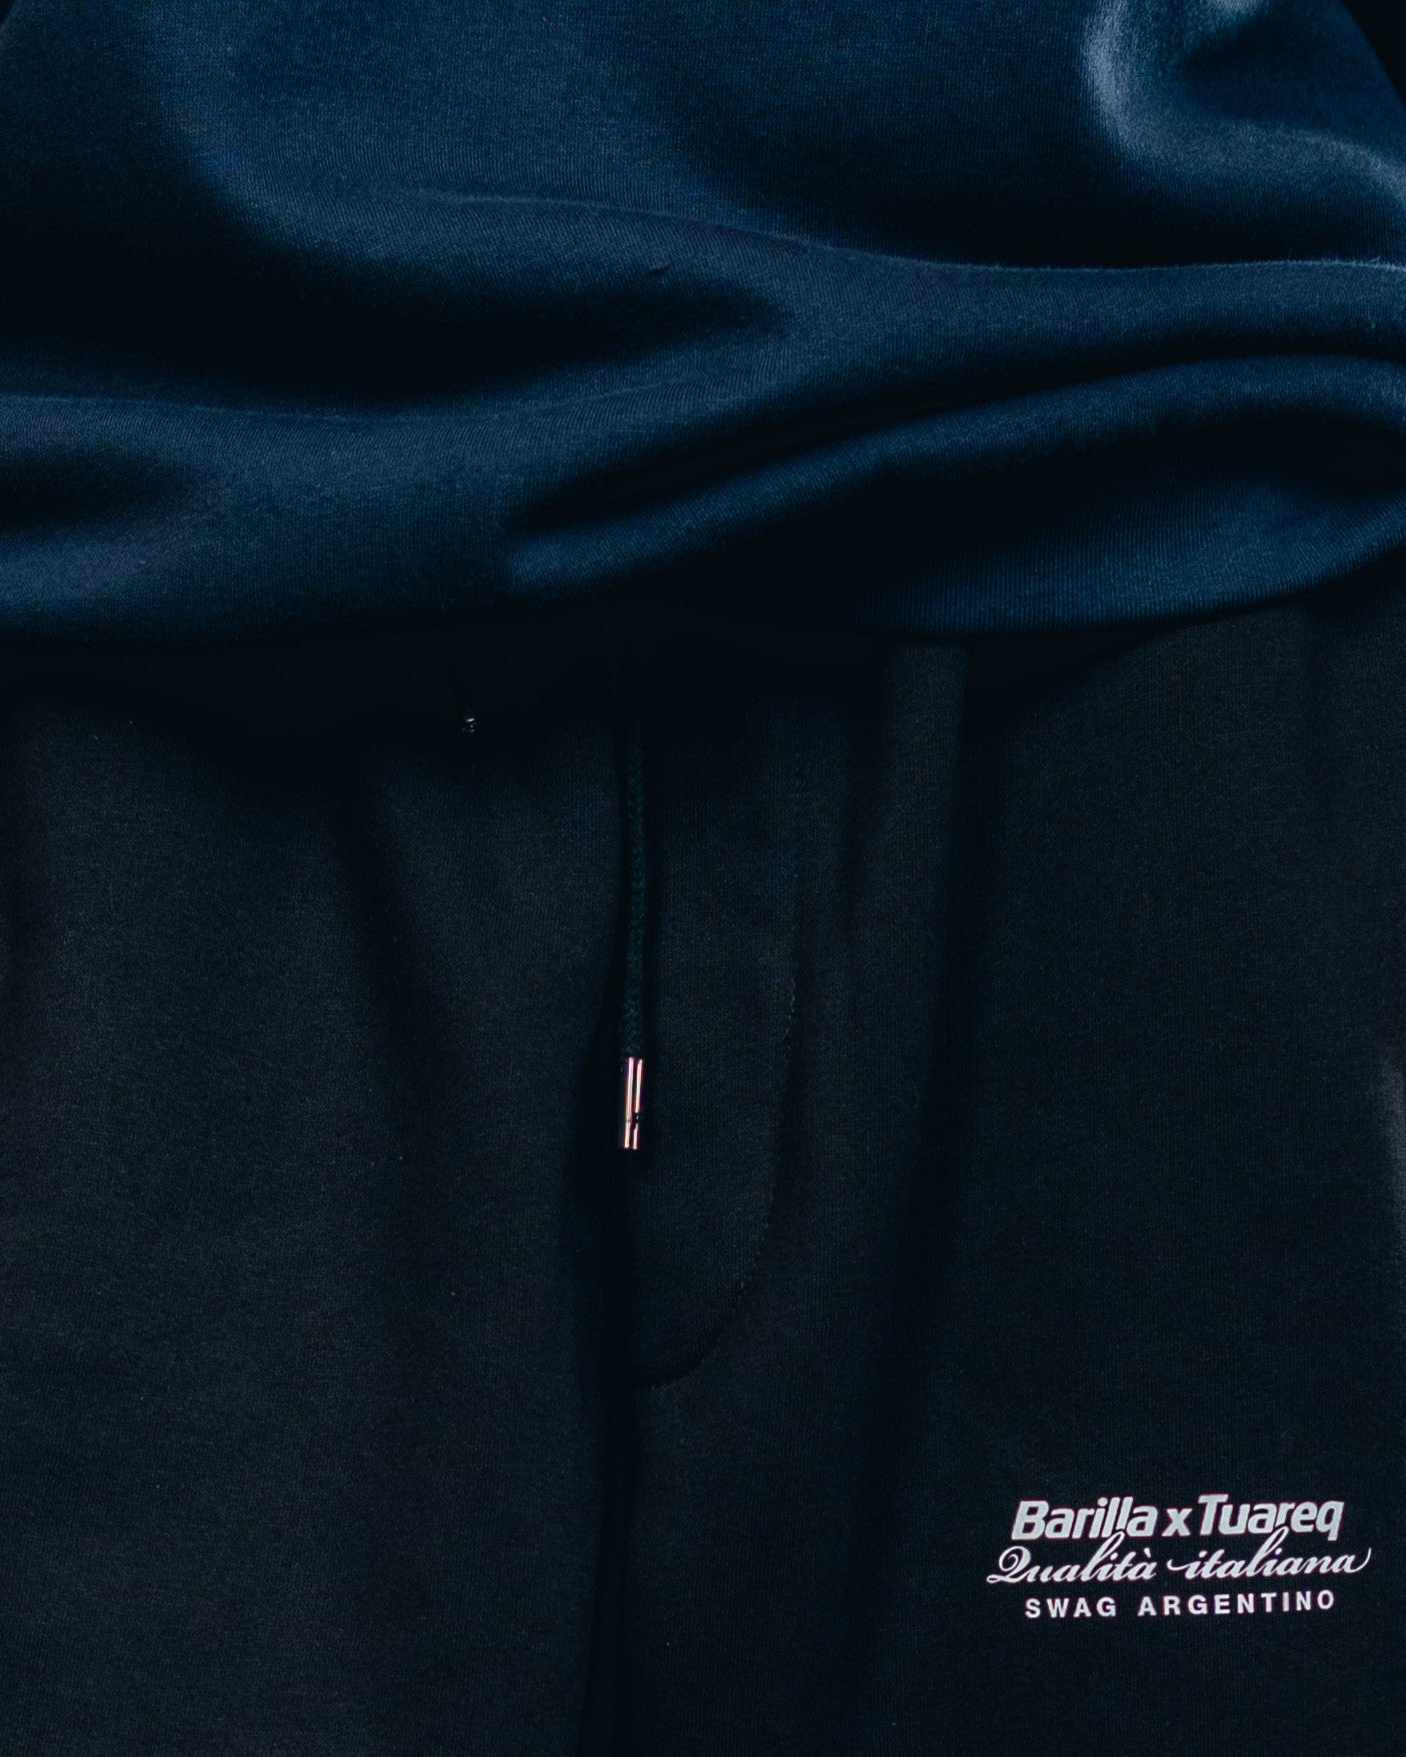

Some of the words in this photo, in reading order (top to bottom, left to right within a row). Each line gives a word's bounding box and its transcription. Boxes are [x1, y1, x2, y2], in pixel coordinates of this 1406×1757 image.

[1011, 1496, 1159, 1541] Barilla
[1161, 1507, 1193, 1538] x
[986, 1530, 1158, 1584] Qualità
[1166, 1525, 1372, 1580] italiana
[1025, 1596, 1117, 1619] SWAG
[1137, 1589, 1335, 1617] ARGENTINO
